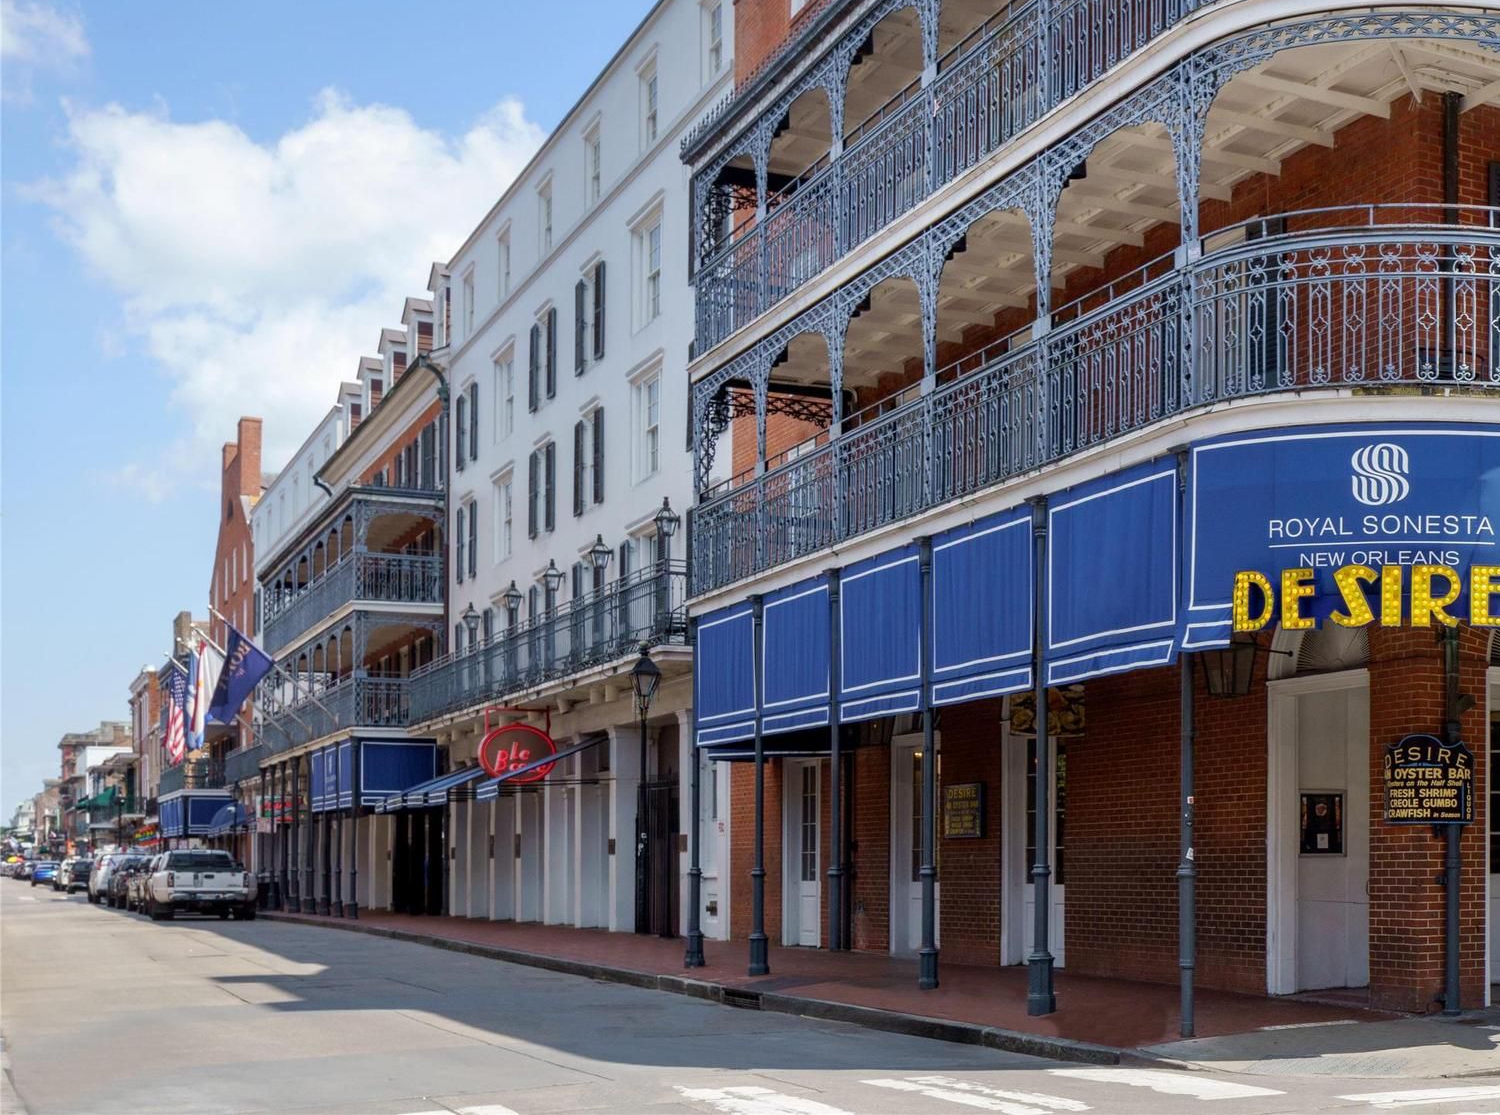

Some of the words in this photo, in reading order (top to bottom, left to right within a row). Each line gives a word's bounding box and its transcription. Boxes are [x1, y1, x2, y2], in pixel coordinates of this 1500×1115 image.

[1269, 516, 1353, 538] ROYAL
[1362, 515, 1495, 535] SONESTA
[1300, 551, 1345, 567] NEW
[1351, 550, 1460, 566] ORLEANS
[1384, 746, 1468, 769] DESIRE
[1394, 767, 1443, 780] OYSTER
[1448, 767, 1472, 780] BAR
[1430, 779, 1445, 787] Half
[1447, 779, 1463, 787] Shell
[948, 789, 976, 798] DESIRE
[1389, 788, 1415, 798] FRESH
[1419, 788, 1458, 798] SHRIMP
[1390, 798, 1419, 808] CREOLE
[1423, 798, 1458, 808] GUMBO
[1388, 808, 1431, 818] CRAWFISH
